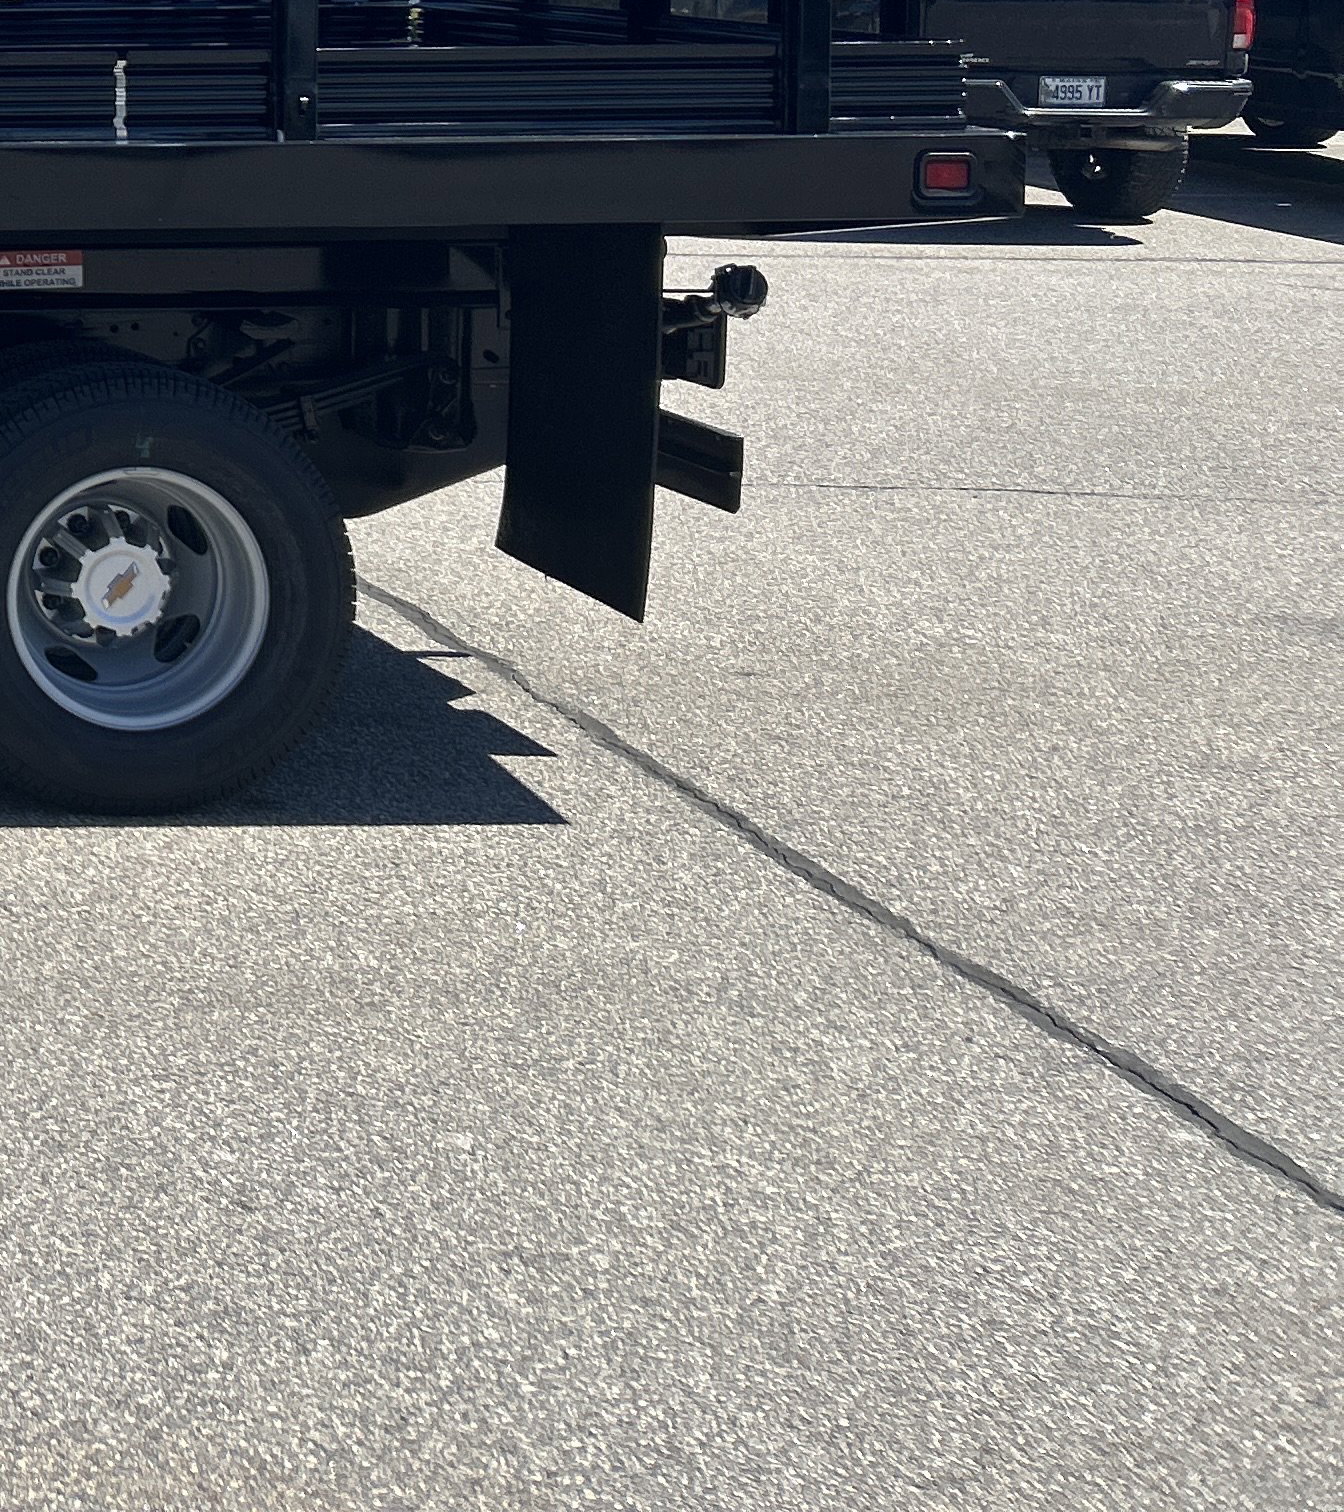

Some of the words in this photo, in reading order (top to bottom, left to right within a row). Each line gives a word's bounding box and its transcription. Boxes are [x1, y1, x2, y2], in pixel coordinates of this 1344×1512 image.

[1052, 84, 1083, 101] 4995
[1087, 84, 1103, 101] YT
[15, 253, 67, 265] DANGER
[3, 268, 34, 277] STAND
[35, 267, 66, 276] CLEAR
[23, 277, 77, 287] OPERATING
